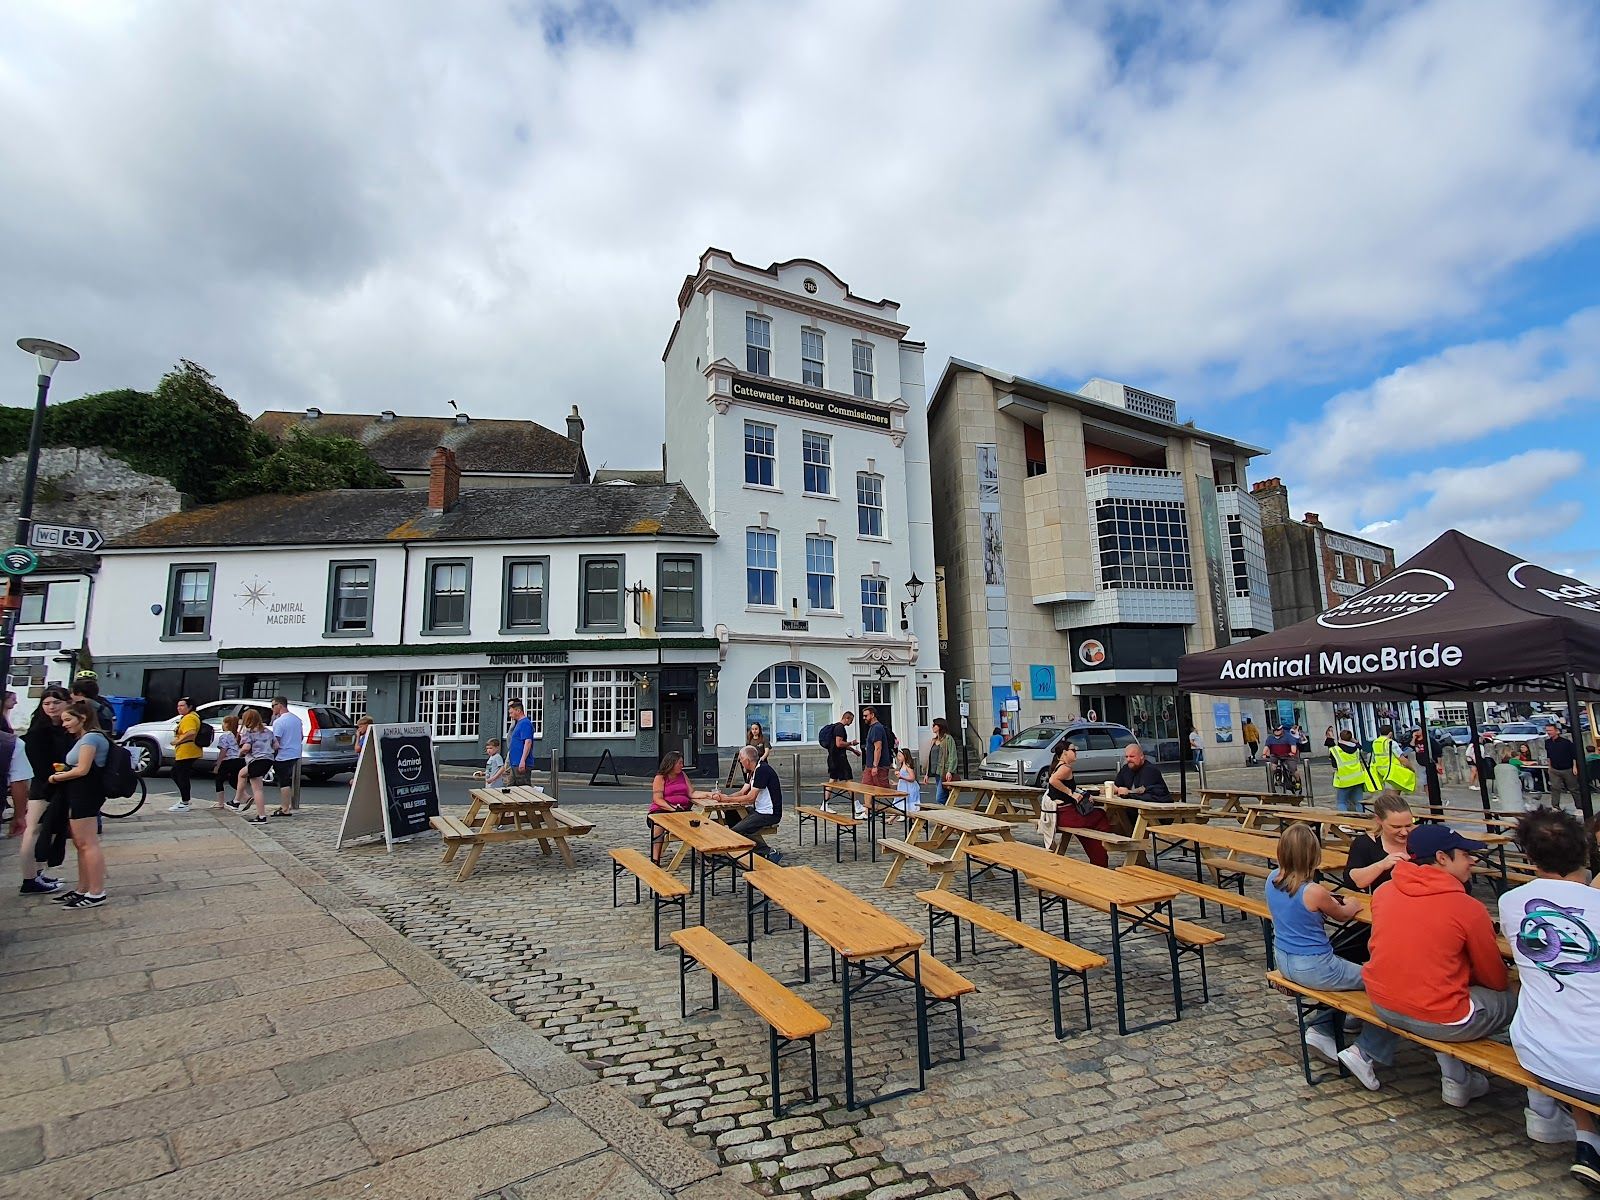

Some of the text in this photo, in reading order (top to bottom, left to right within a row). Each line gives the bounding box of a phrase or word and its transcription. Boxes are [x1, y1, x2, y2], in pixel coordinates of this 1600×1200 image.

[733, 384, 889, 424] Cattewater Harbour Commissioners
[40, 531, 57, 541] WC
[1214, 581, 1225, 632] MUSEUM
[1340, 591, 1450, 610] Admiral
[270, 602, 304, 613] ADMIRAL
[266, 614, 307, 625] MACBRIDE
[489, 652, 569, 665] ADMIRAL MACBRIDE
[1219, 642, 1463, 680] Admiral MacBride
[383, 727, 403, 736] ADMIRAL
[398, 757, 422, 767] Admiral
